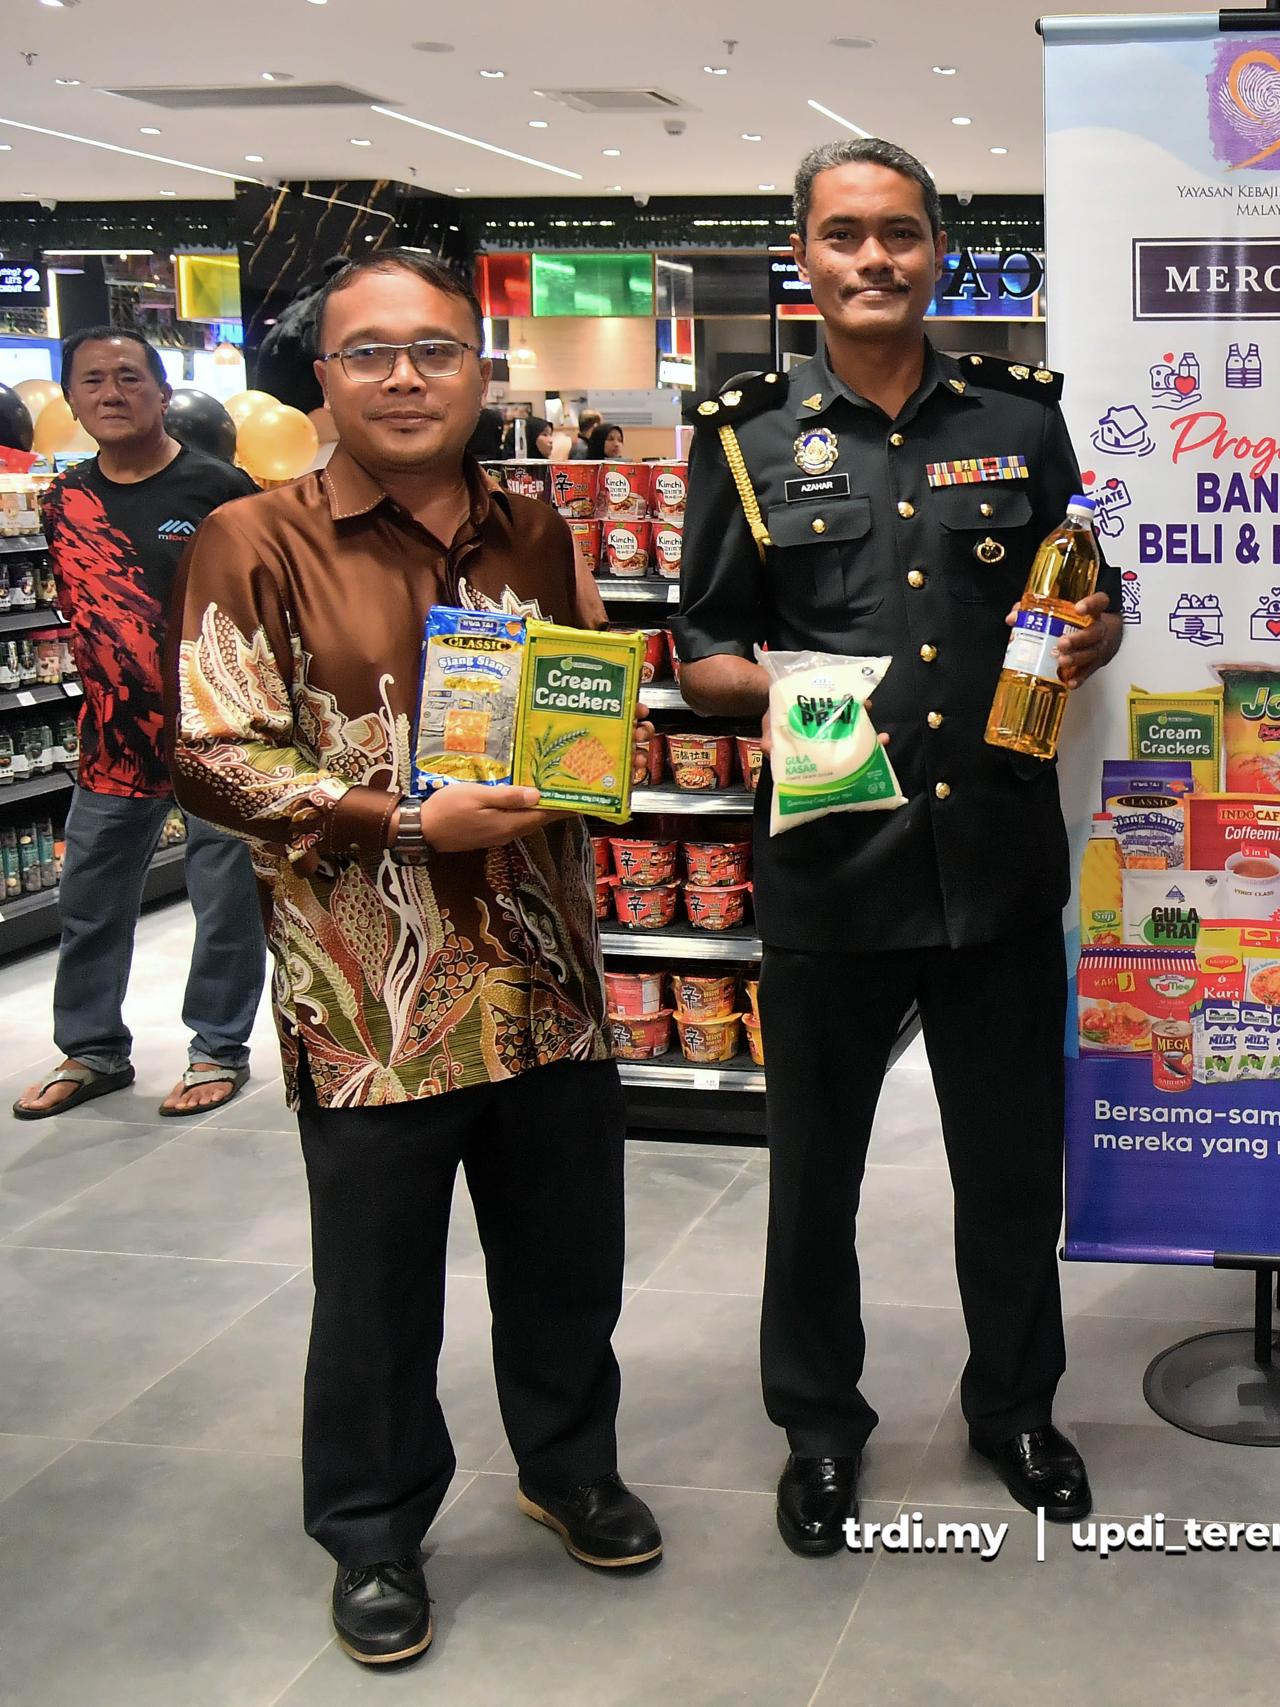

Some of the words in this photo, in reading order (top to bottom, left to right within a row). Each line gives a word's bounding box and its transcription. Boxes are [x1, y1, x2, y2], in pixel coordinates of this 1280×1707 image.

[1177, 185, 1233, 198] YAYASAN
[23, 268, 41, 292] 2
[606, 477, 627, 487] Kimchi
[658, 479, 682, 488] Kimchi
[800, 481, 834, 493] AZAHAR
[1095, 489, 1124, 508] NATE
[158, 534, 191, 542] mforc
[610, 534, 634, 543] Kimchi
[1138, 523, 1223, 564] BELI
[1235, 524, 1260, 564] &
[448, 637, 511, 651] CLASSIC
[548, 669, 612, 693] Cream
[535, 687, 621, 713] Crackers
[1149, 725, 1202, 740] Cream
[1140, 741, 1211, 755] Crackers
[785, 755, 812, 766] GULA
[785, 763, 818, 775] KASAR
[1122, 799, 1171, 807] CLASSIC
[1113, 814, 1146, 828] Siang
[1149, 813, 1184, 831] Siang
[1151, 907, 1199, 923] GULA
[1153, 923, 1197, 939] PRAI
[1203, 987, 1239, 999] Kari
[1157, 1037, 1191, 1051] MEGA
[1208, 1035, 1237, 1046] MILK
[1244, 1036, 1270, 1046] MILK
[1093, 1131, 1193, 1152] mereka
[1201, 1137, 1268, 1159] yang
